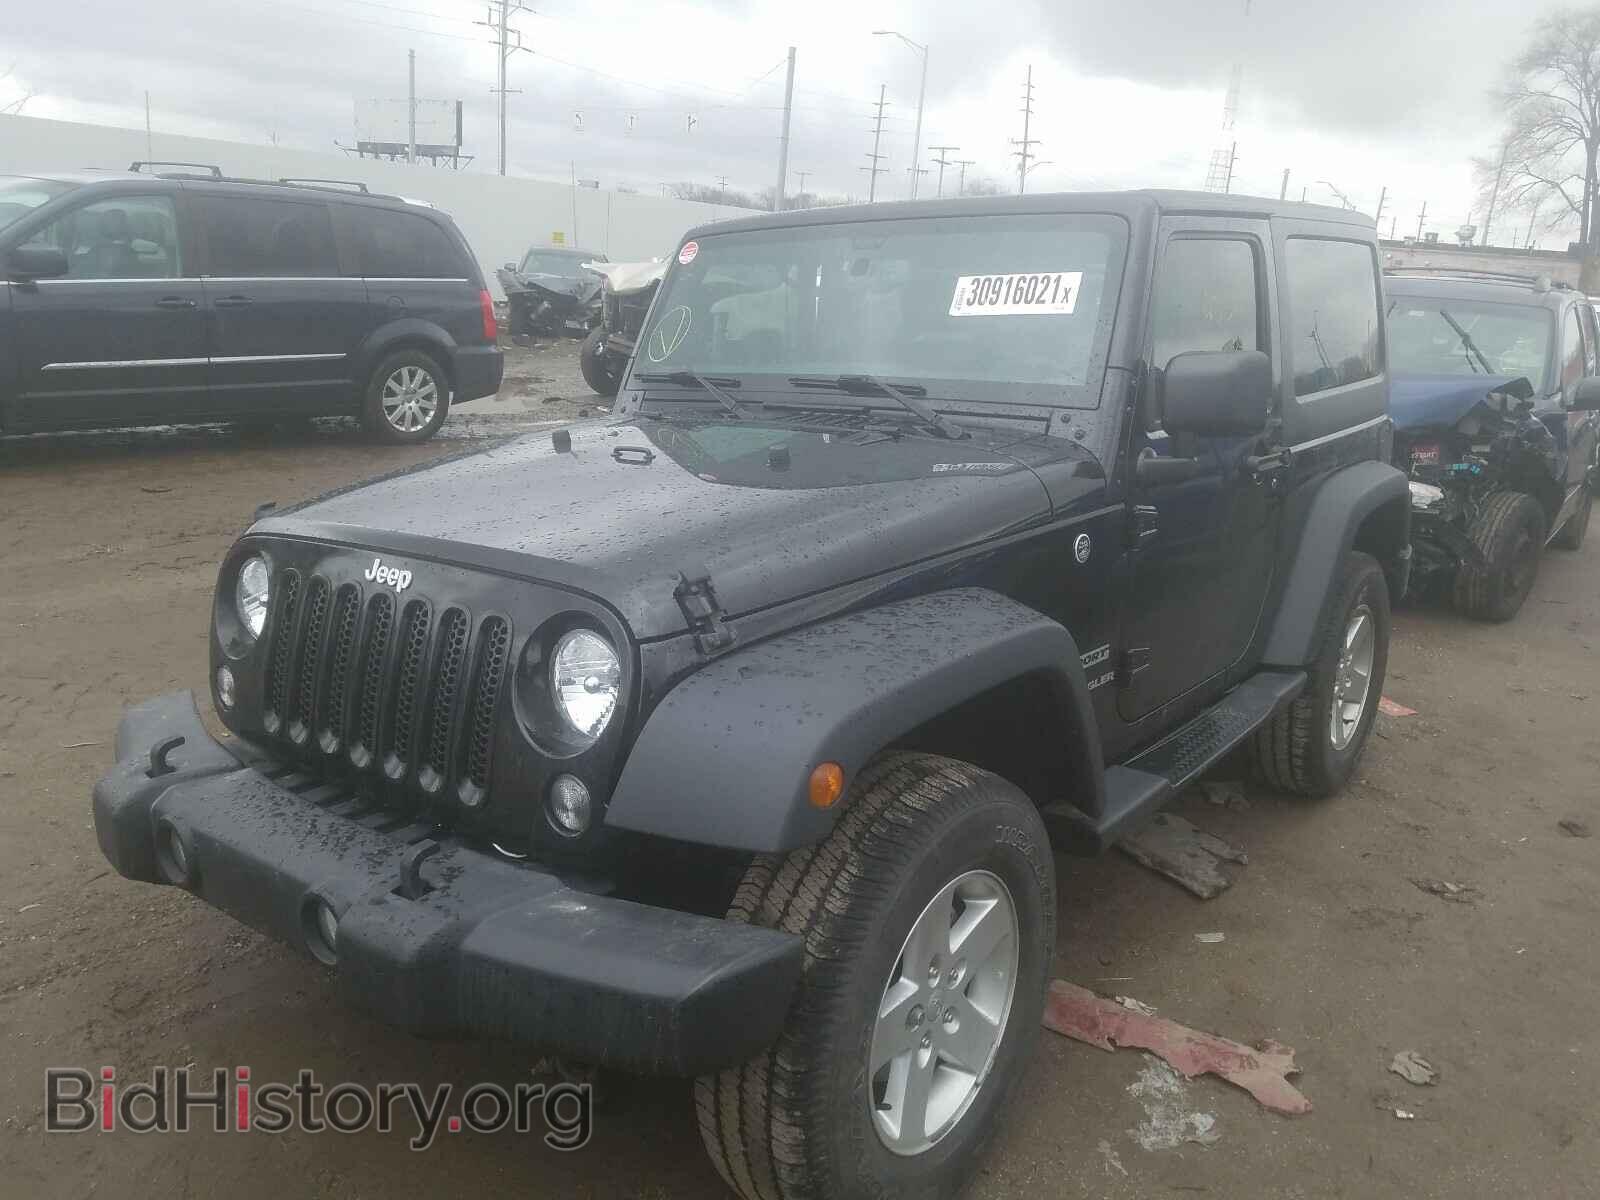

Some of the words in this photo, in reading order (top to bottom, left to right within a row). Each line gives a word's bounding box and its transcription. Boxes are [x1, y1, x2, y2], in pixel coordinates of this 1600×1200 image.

[967, 274, 1062, 306] 30916021
[365, 558, 412, 593] Jeep
[1081, 646, 1109, 667] ORT
[1088, 671, 1114, 690] GLER
